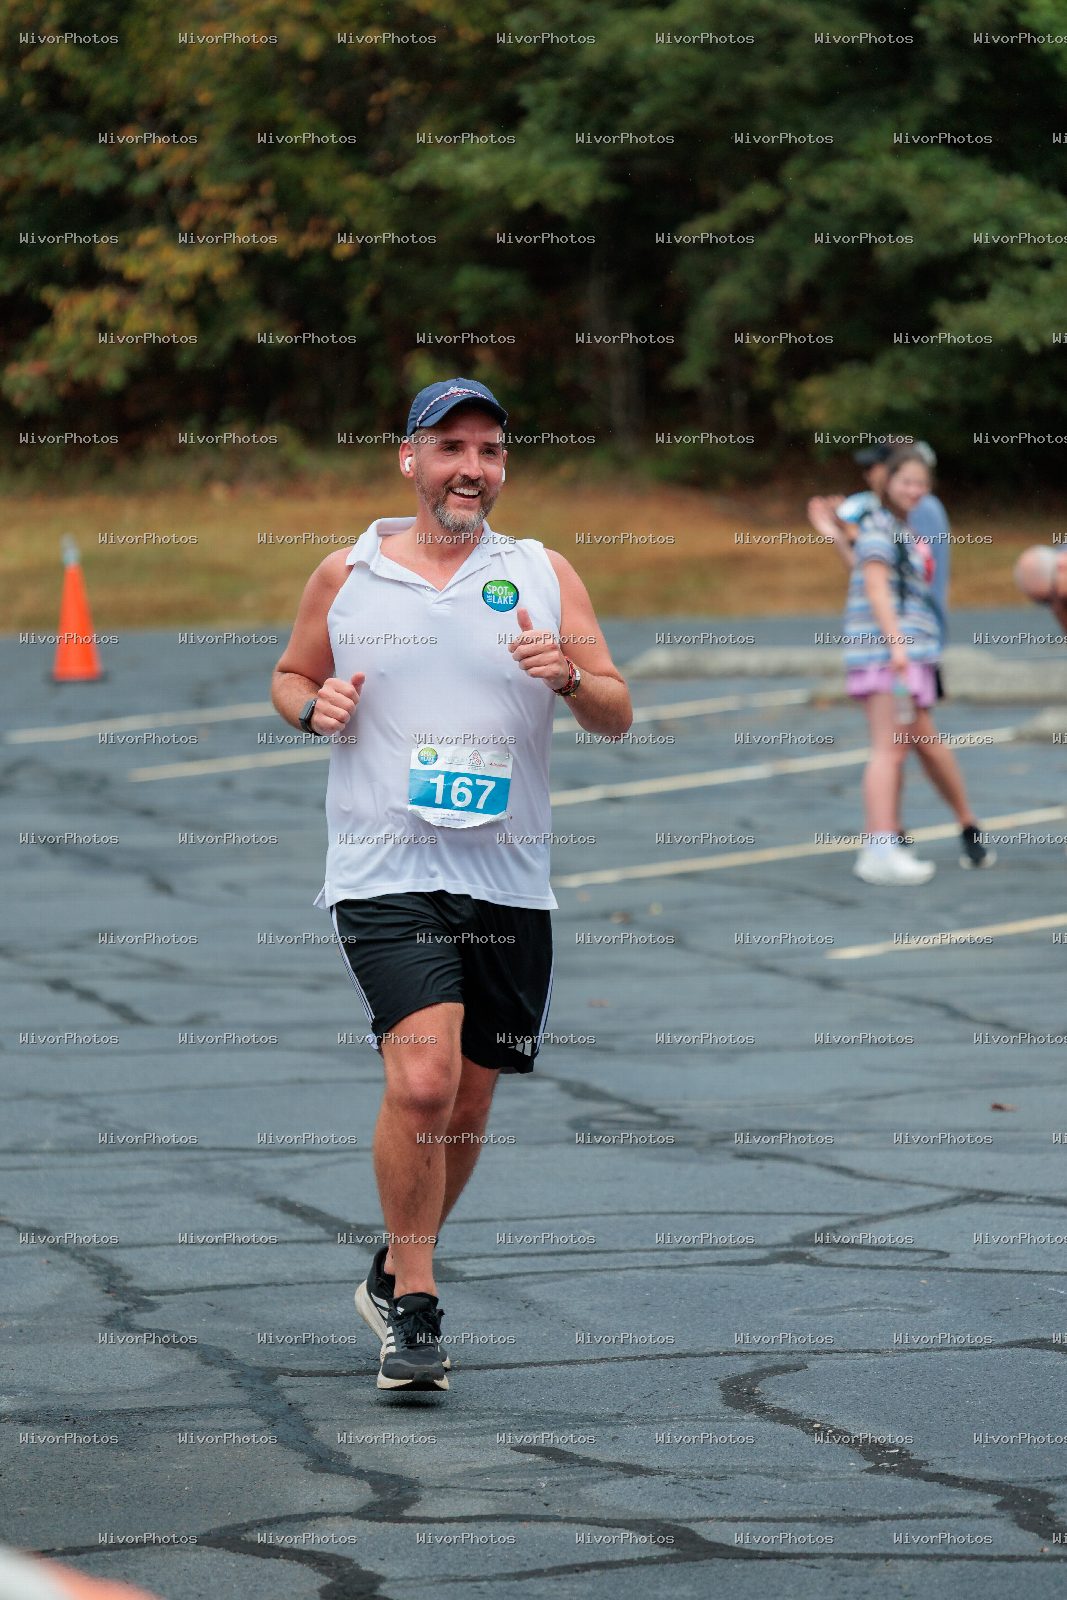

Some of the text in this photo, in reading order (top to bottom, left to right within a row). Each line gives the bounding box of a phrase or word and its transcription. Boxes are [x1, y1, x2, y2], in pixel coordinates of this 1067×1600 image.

[486, 585, 508, 596] SPOT
[492, 595, 514, 605] LAKE
[430, 774, 496, 809] 167
